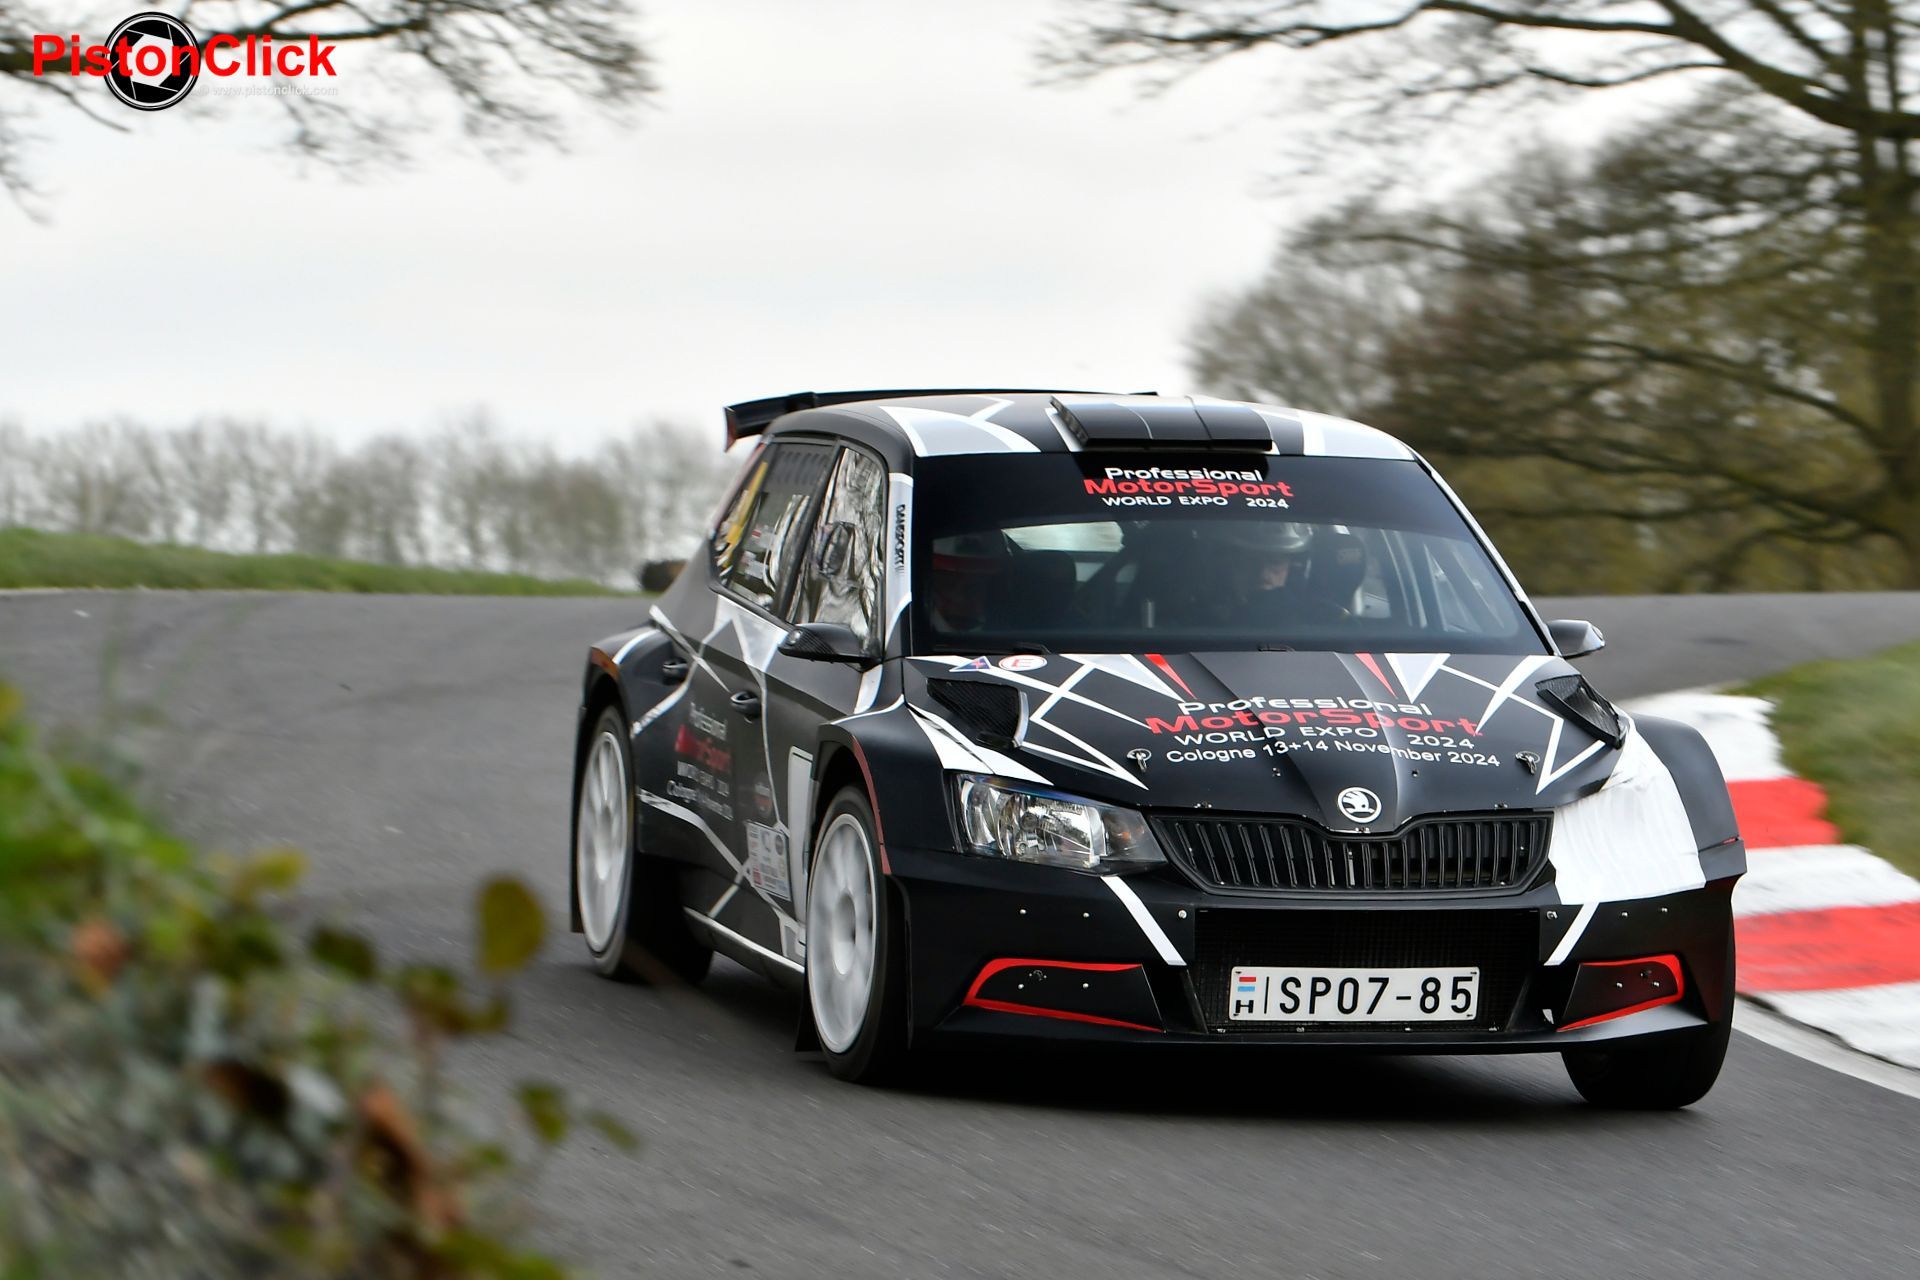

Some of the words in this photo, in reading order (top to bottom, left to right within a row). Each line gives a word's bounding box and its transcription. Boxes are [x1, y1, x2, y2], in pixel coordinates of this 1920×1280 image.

[1104, 467, 1263, 482] Professional
[1083, 479, 1295, 497] MotorSport
[1102, 496, 1172, 507] WORLD
[1179, 496, 1228, 506] EXPO
[1245, 497, 1290, 509] 2024
[1178, 696, 1433, 716] Professional
[1145, 708, 1484, 736] MotorSport
[1174, 726, 1286, 746] WORLD
[1299, 726, 1378, 738] EXPO
[1407, 734, 1475, 749] 2024
[1166, 748, 1256, 763] Cologne
[1262, 739, 1329, 757] 13+14
[1334, 740, 1442, 762] November
[1447, 751, 1501, 767] 2024
[1234, 1000, 1254, 1013] H
